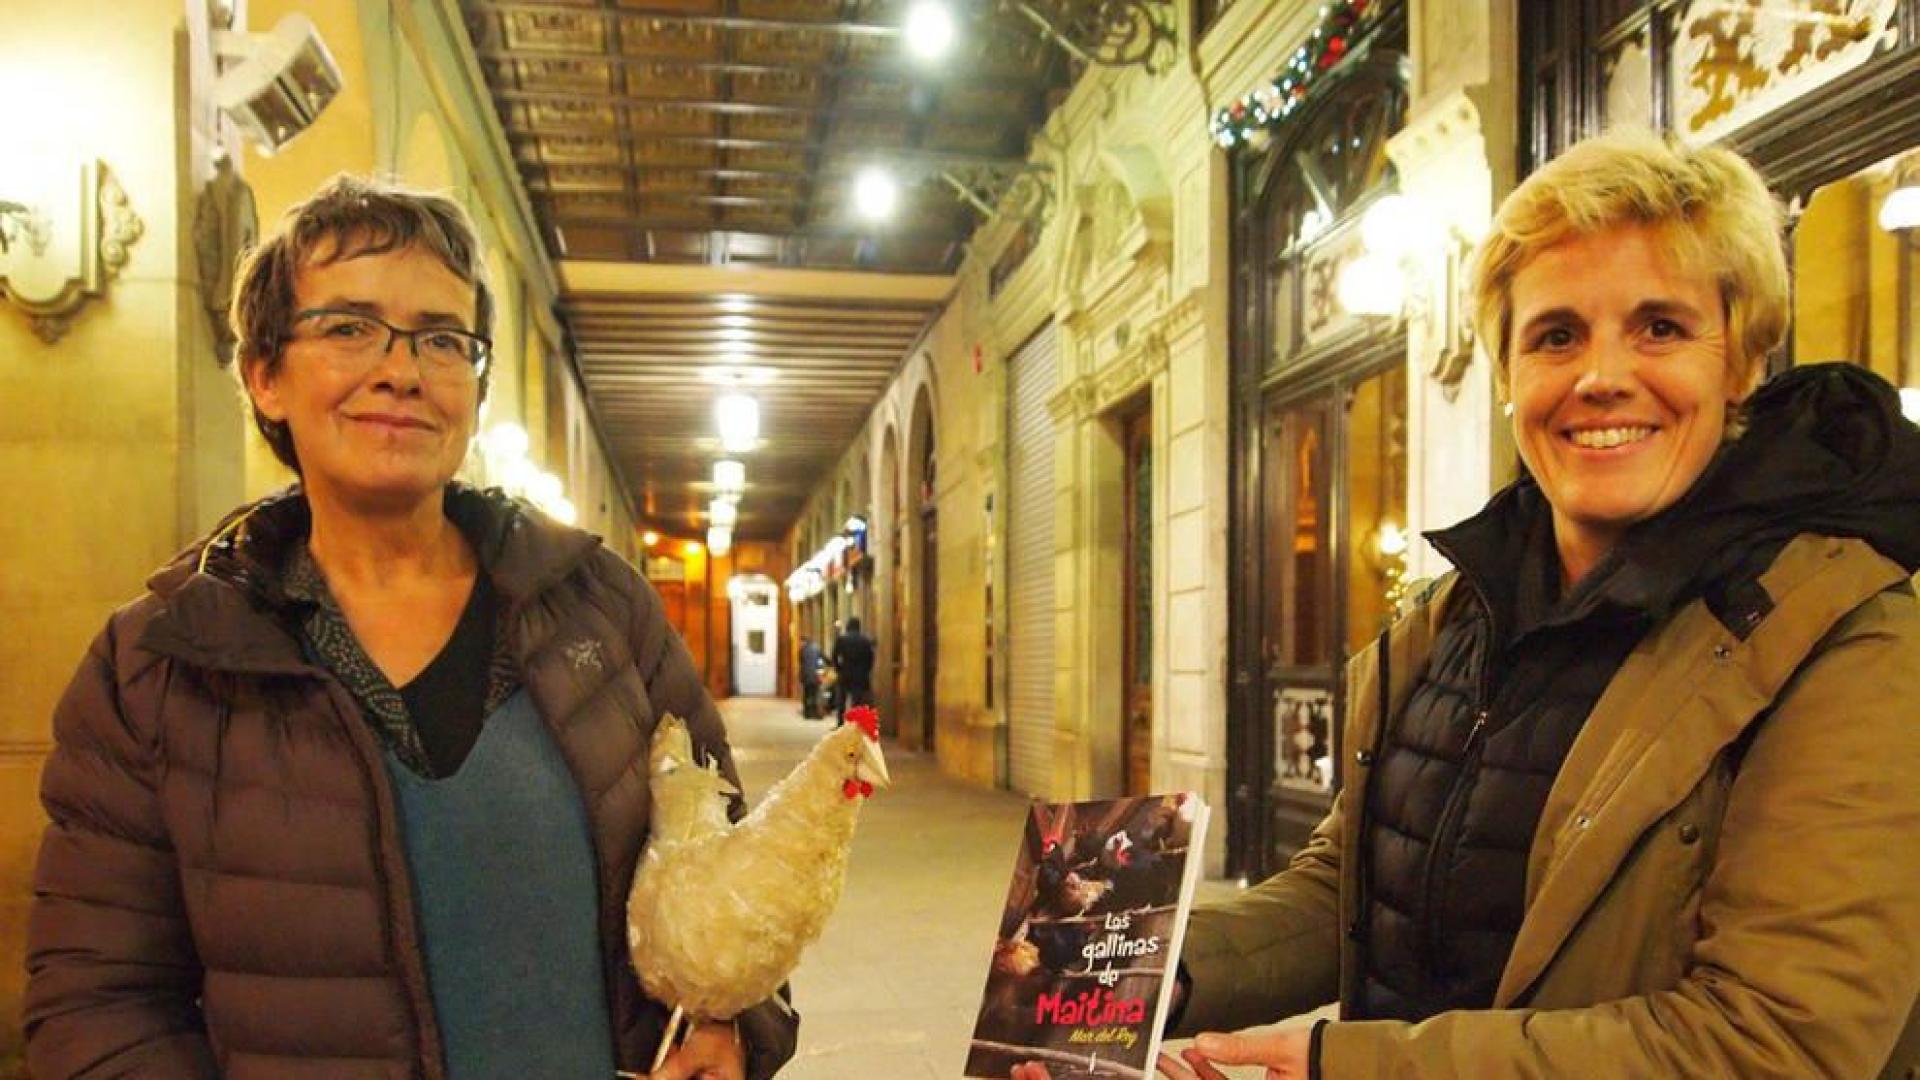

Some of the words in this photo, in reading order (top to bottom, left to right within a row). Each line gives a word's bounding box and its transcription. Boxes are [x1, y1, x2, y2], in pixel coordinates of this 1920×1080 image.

[1104, 912, 1131, 930] Las
[1082, 933, 1159, 973] gallinas
[1098, 961, 1119, 987] de
[1036, 988, 1146, 1025] Maitina
